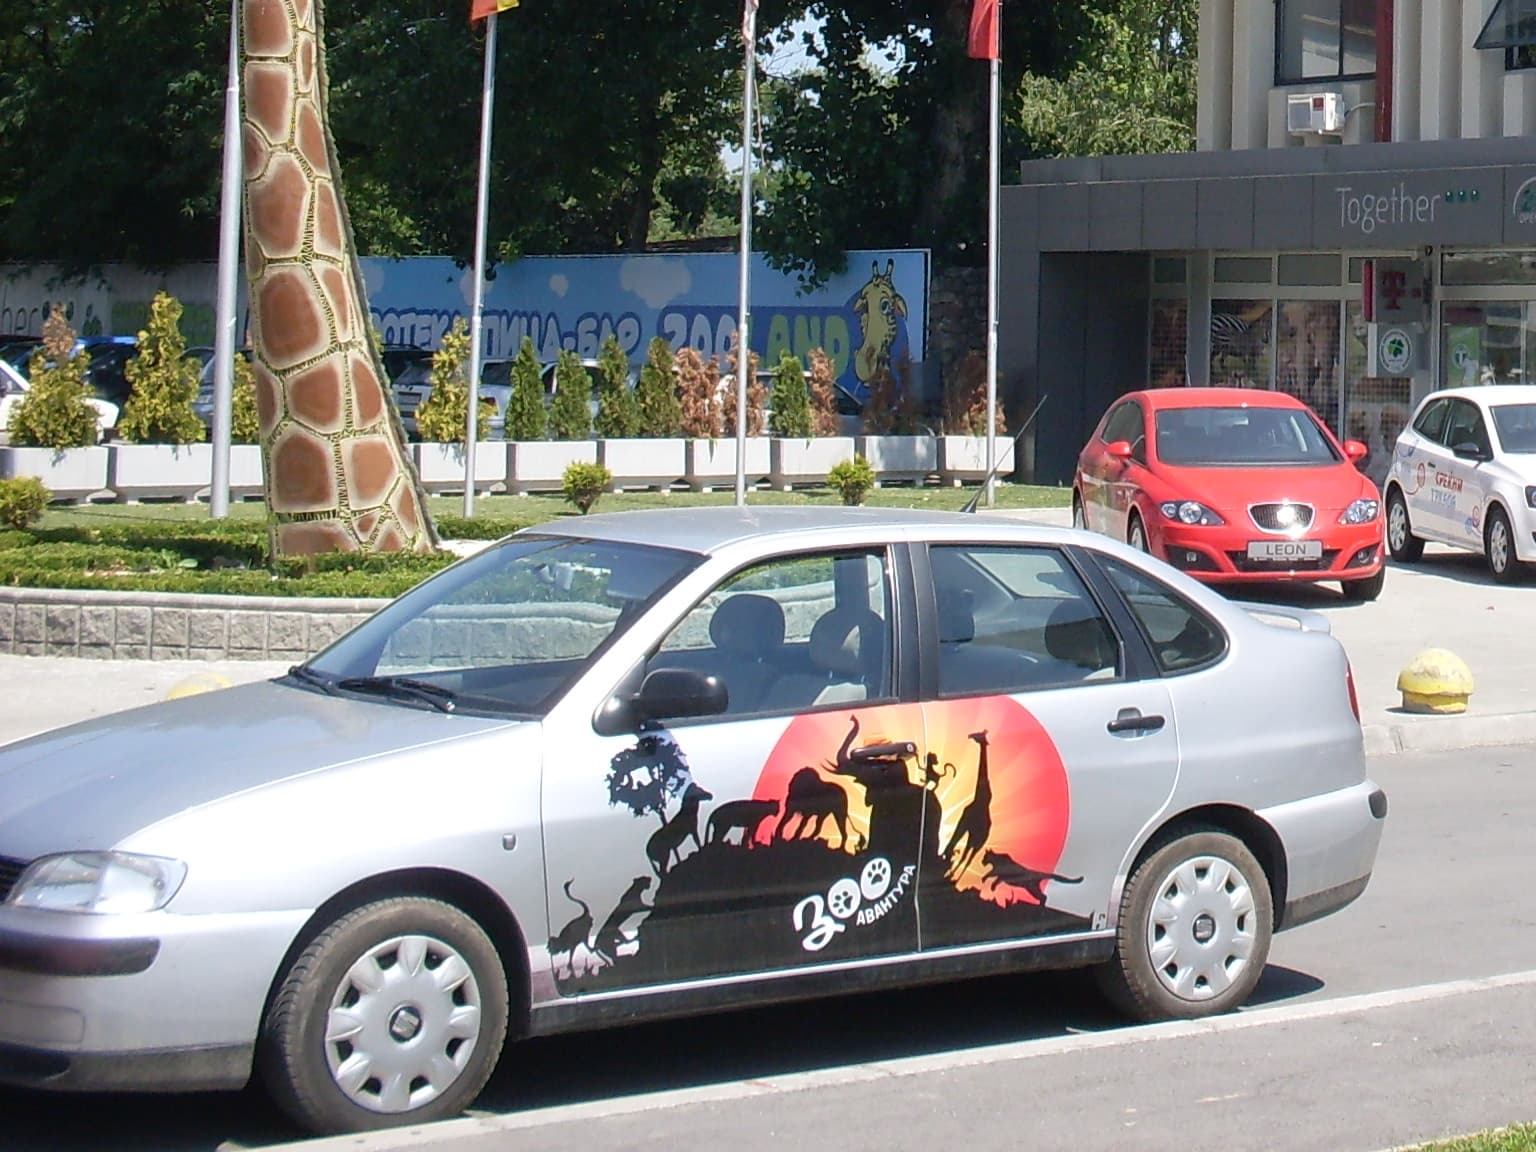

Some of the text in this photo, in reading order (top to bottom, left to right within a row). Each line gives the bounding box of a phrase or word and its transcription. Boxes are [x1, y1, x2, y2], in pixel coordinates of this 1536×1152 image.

[1335, 182, 1441, 234] Together
[1266, 543, 1306, 556] LEON
[856, 864, 917, 927] АВАНТУРА
